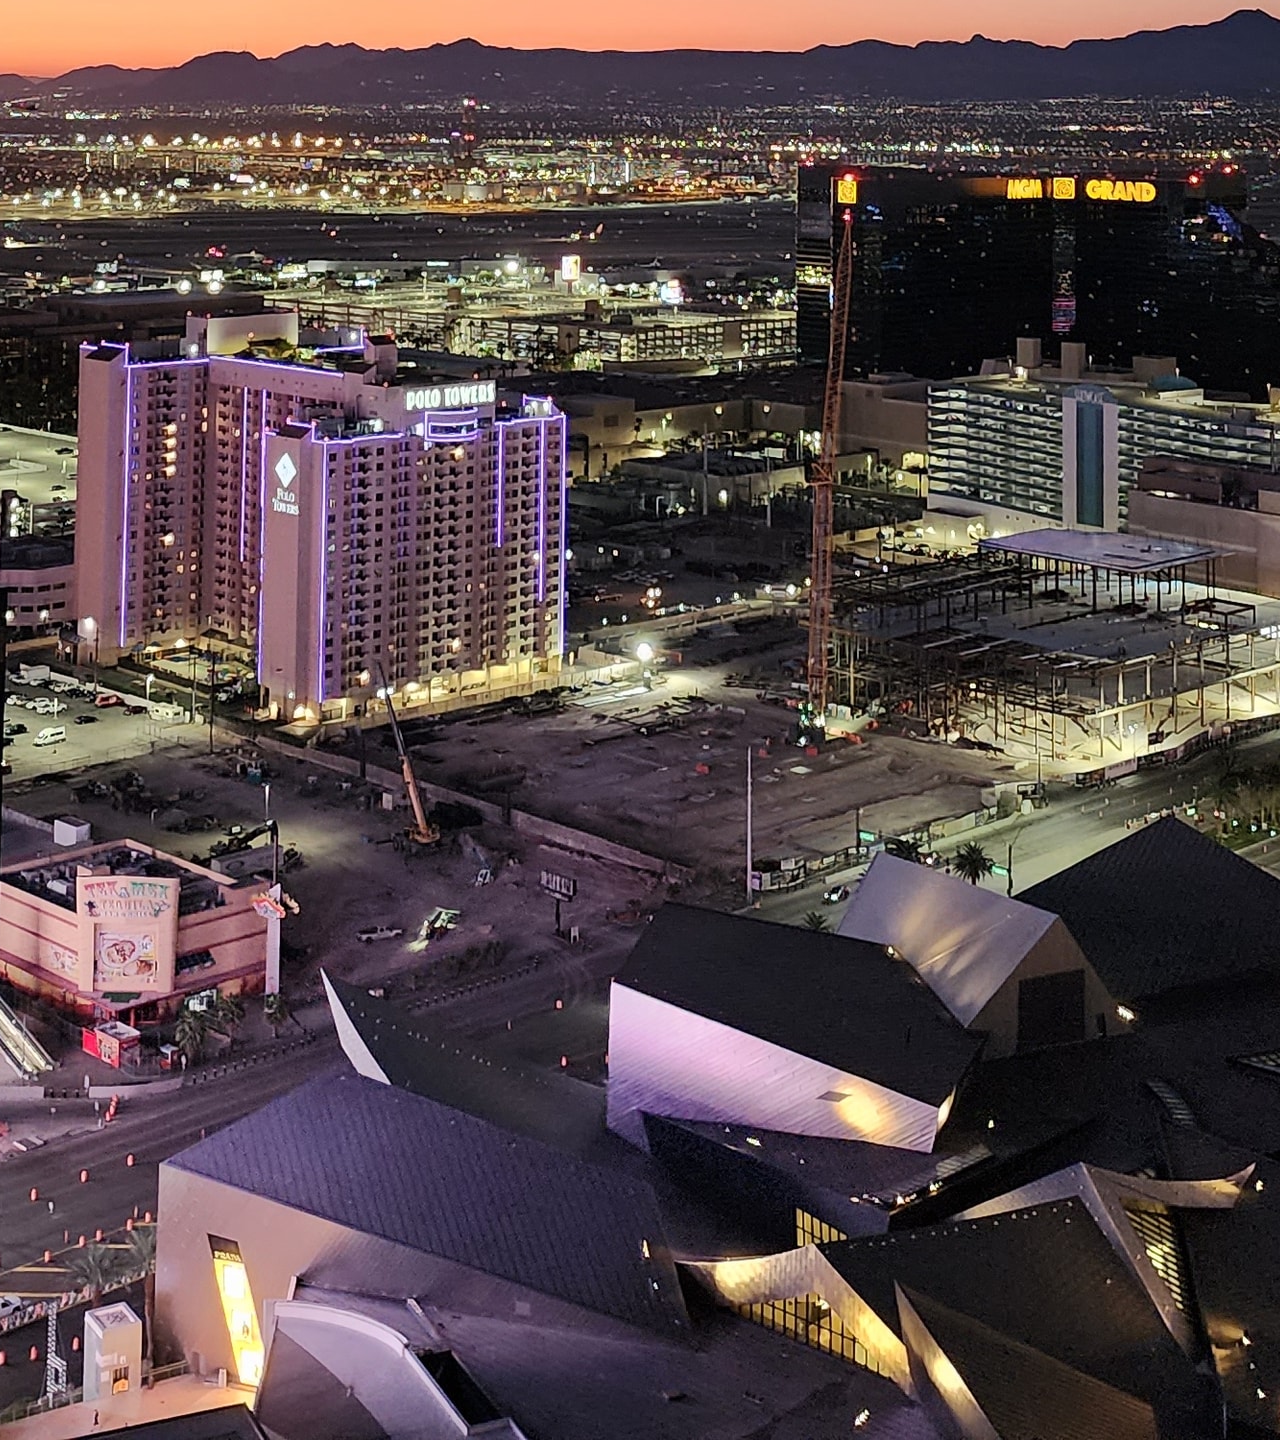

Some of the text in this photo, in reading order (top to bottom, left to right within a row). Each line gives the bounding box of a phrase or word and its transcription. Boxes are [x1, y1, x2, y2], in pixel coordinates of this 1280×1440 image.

[1007, 179, 1156, 202] MGM GRAND
[406, 383, 495, 410] POLO TOWERS
